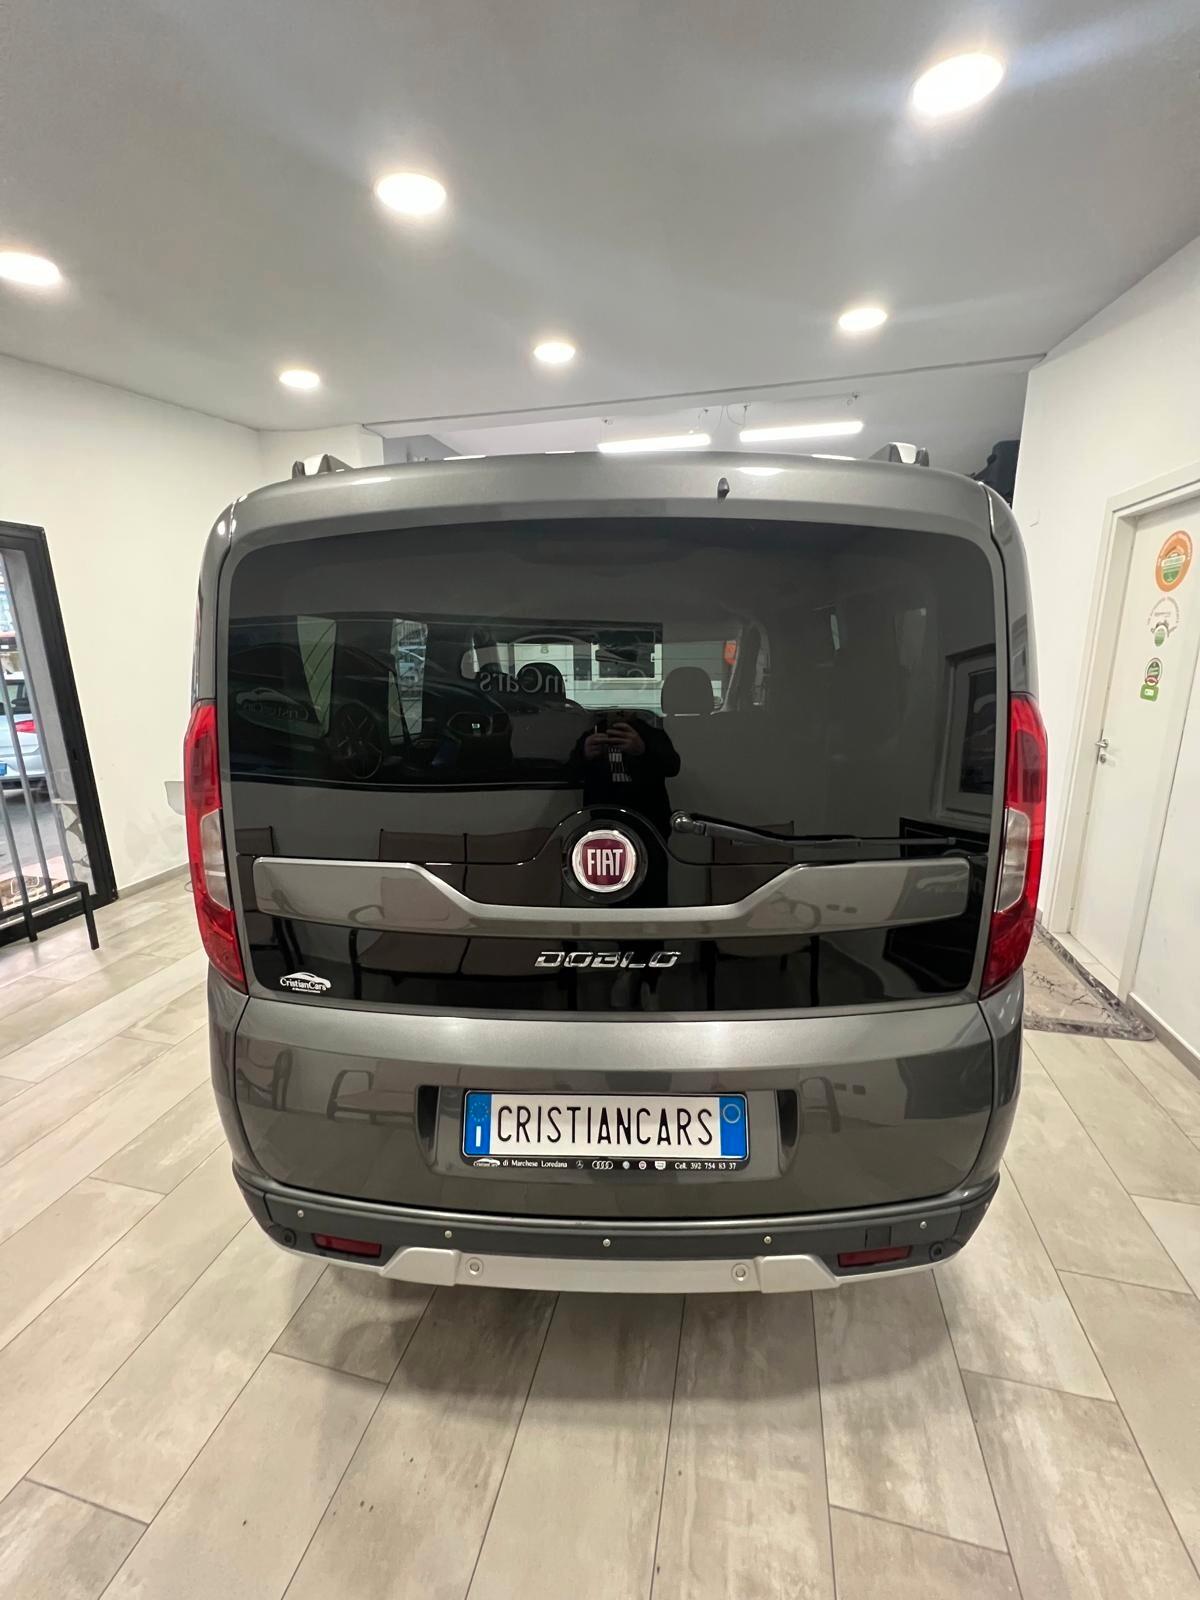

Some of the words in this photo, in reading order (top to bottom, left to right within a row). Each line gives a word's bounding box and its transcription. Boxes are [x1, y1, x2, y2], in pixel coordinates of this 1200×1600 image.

[587, 849, 623, 876] FIAT
[497, 1105, 713, 1146] CRISTIANCARS
[511, 1160, 539, 1168] Marchese
[541, 1160, 568, 1168] Loredana
[690, 1162, 702, 1170] 392
[704, 1161, 716, 1170] 754
[728, 1161, 737, 1170] 37
